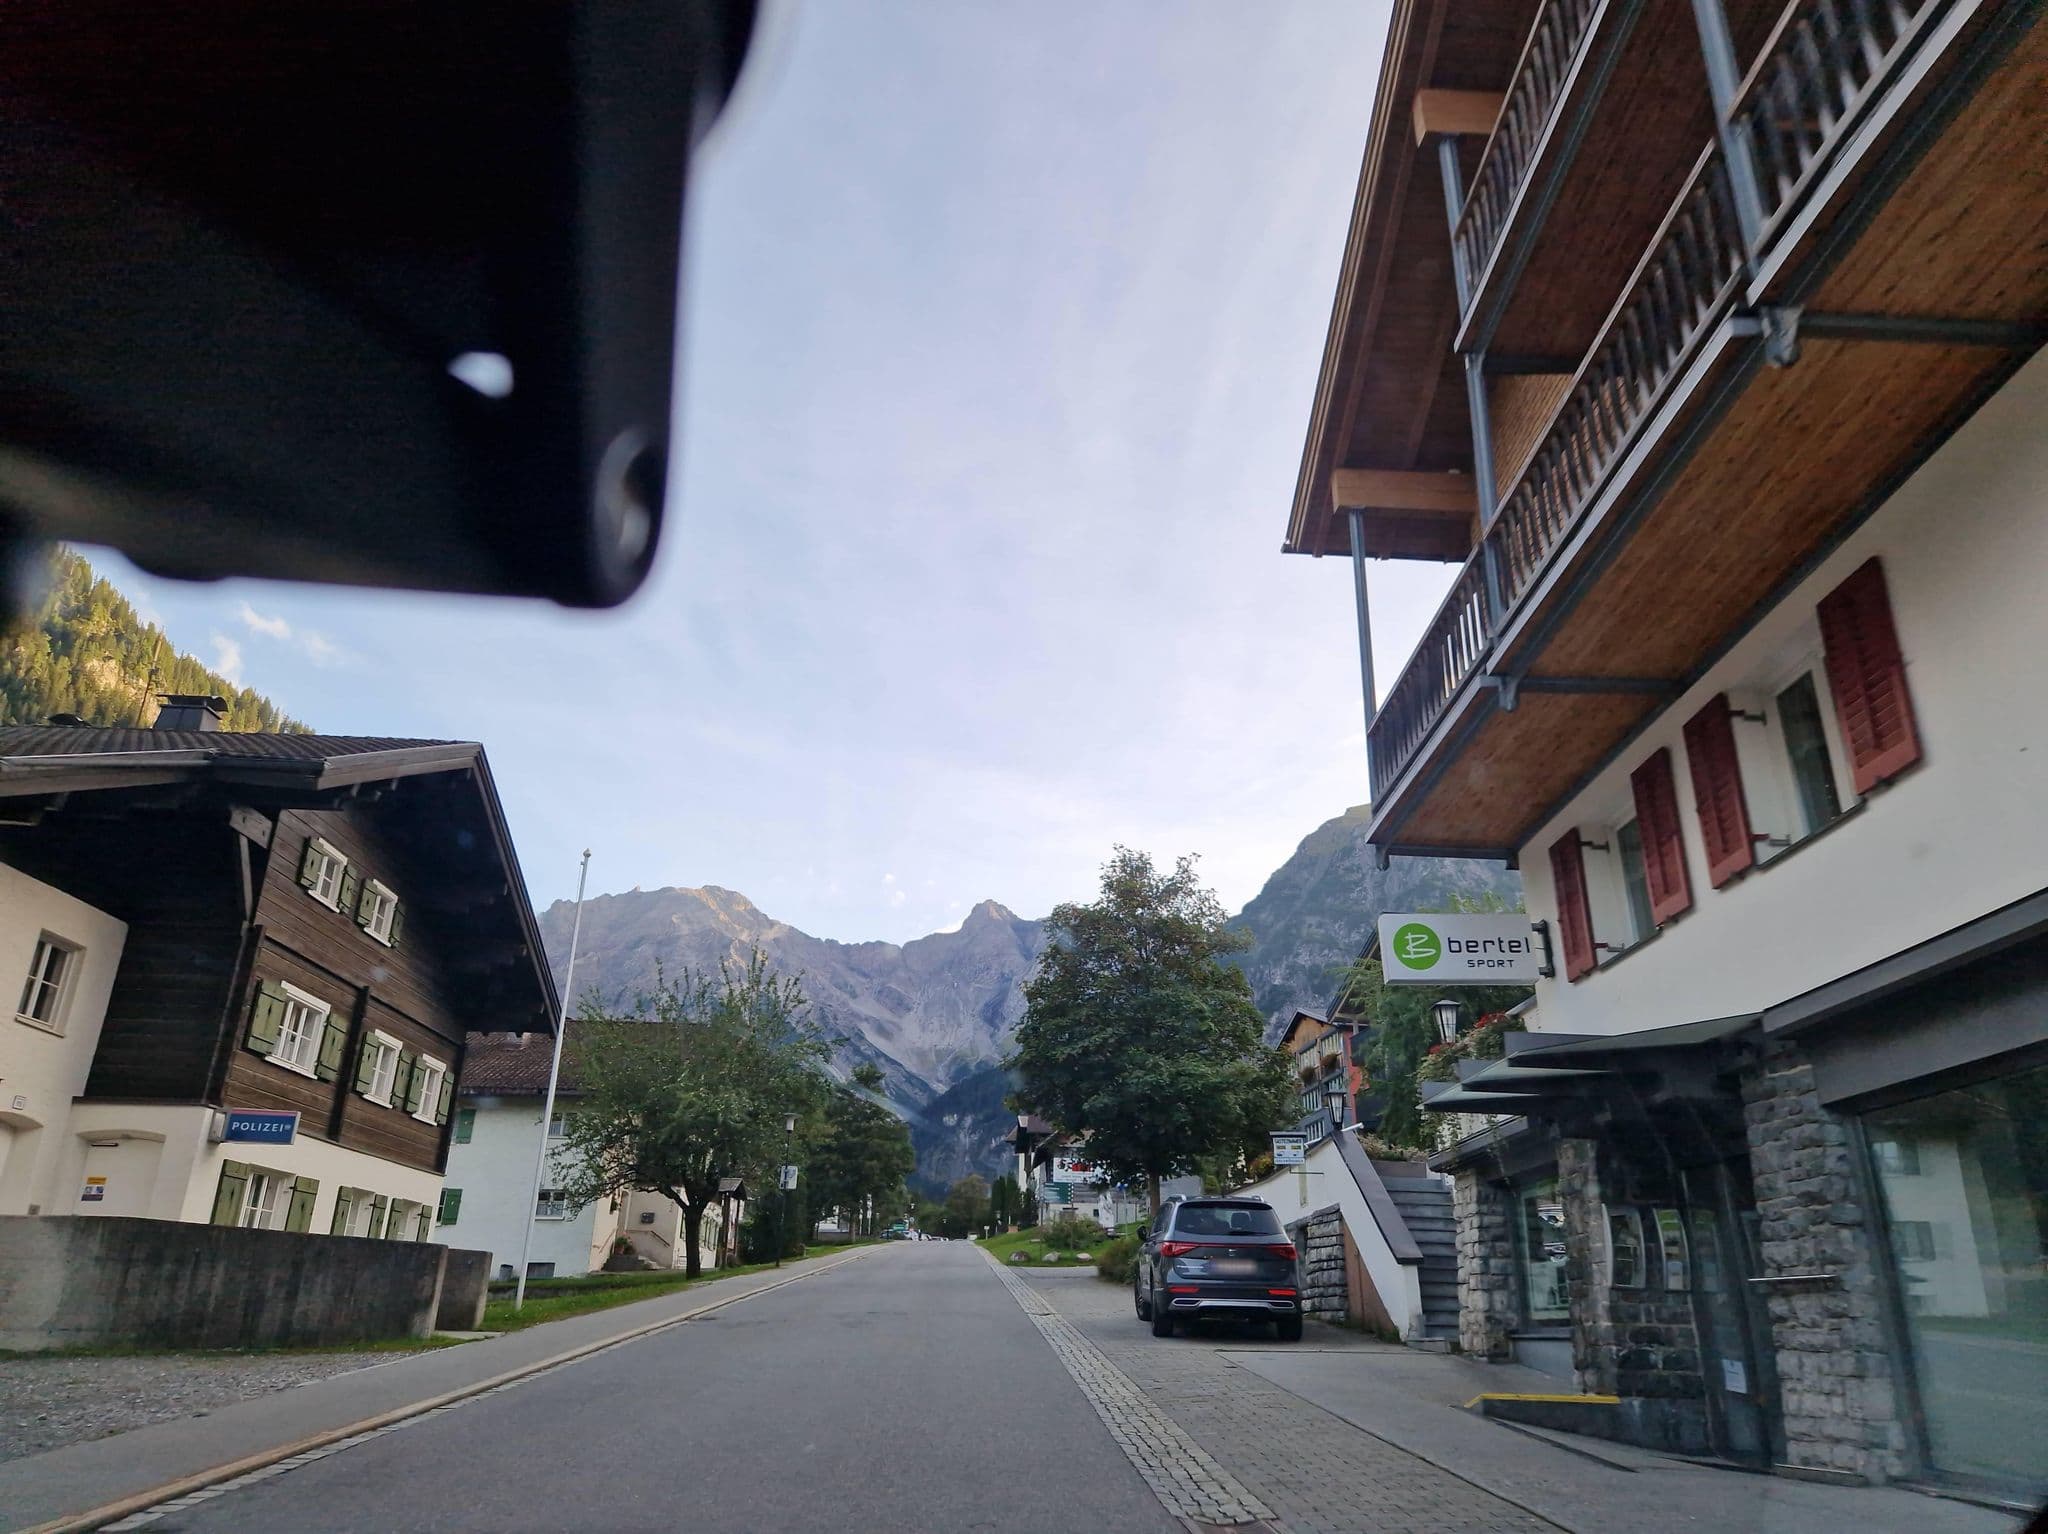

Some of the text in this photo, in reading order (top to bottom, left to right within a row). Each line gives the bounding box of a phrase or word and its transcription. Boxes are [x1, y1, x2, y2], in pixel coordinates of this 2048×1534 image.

[1447, 936, 1531, 954] bertel
[1467, 959, 1515, 968] SPORT
[231, 1121, 284, 1132] POLIZEI
